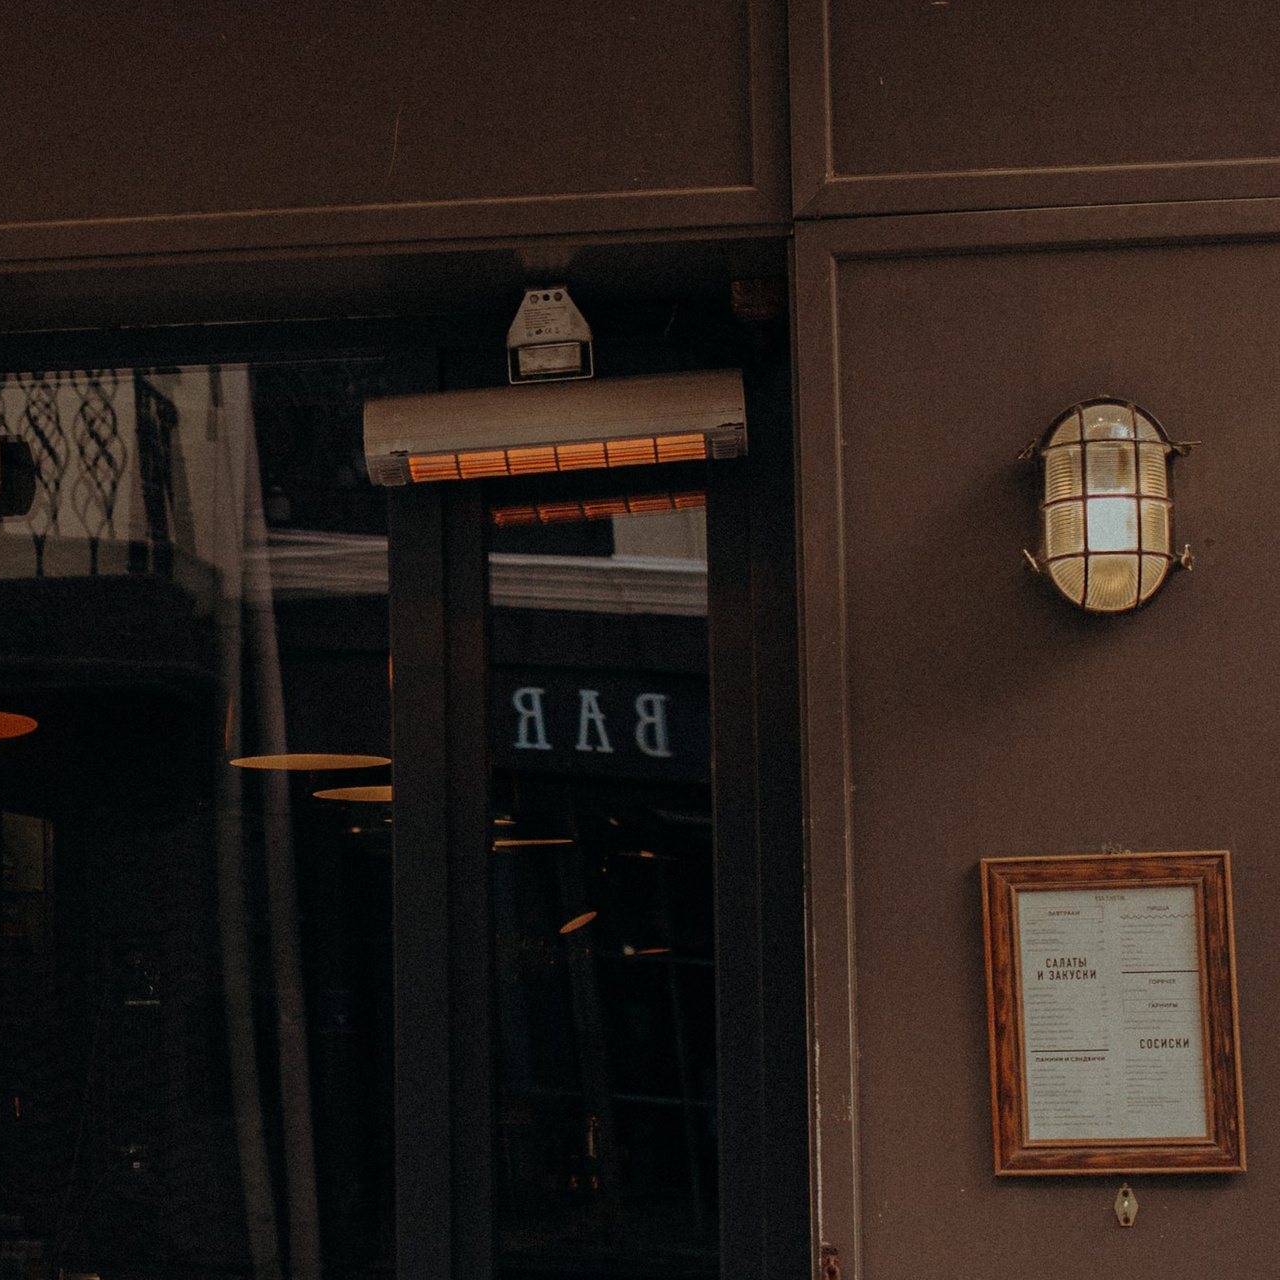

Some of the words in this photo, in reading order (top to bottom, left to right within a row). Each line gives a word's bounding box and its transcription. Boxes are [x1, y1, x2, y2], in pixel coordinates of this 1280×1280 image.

[1045, 957, 1087, 968] САЛАТЫ
[1037, 971, 1044, 980] И
[1049, 969, 1097, 980] ЗАКУСКИ
[1139, 1038, 1190, 1049] СОСИСКИ
